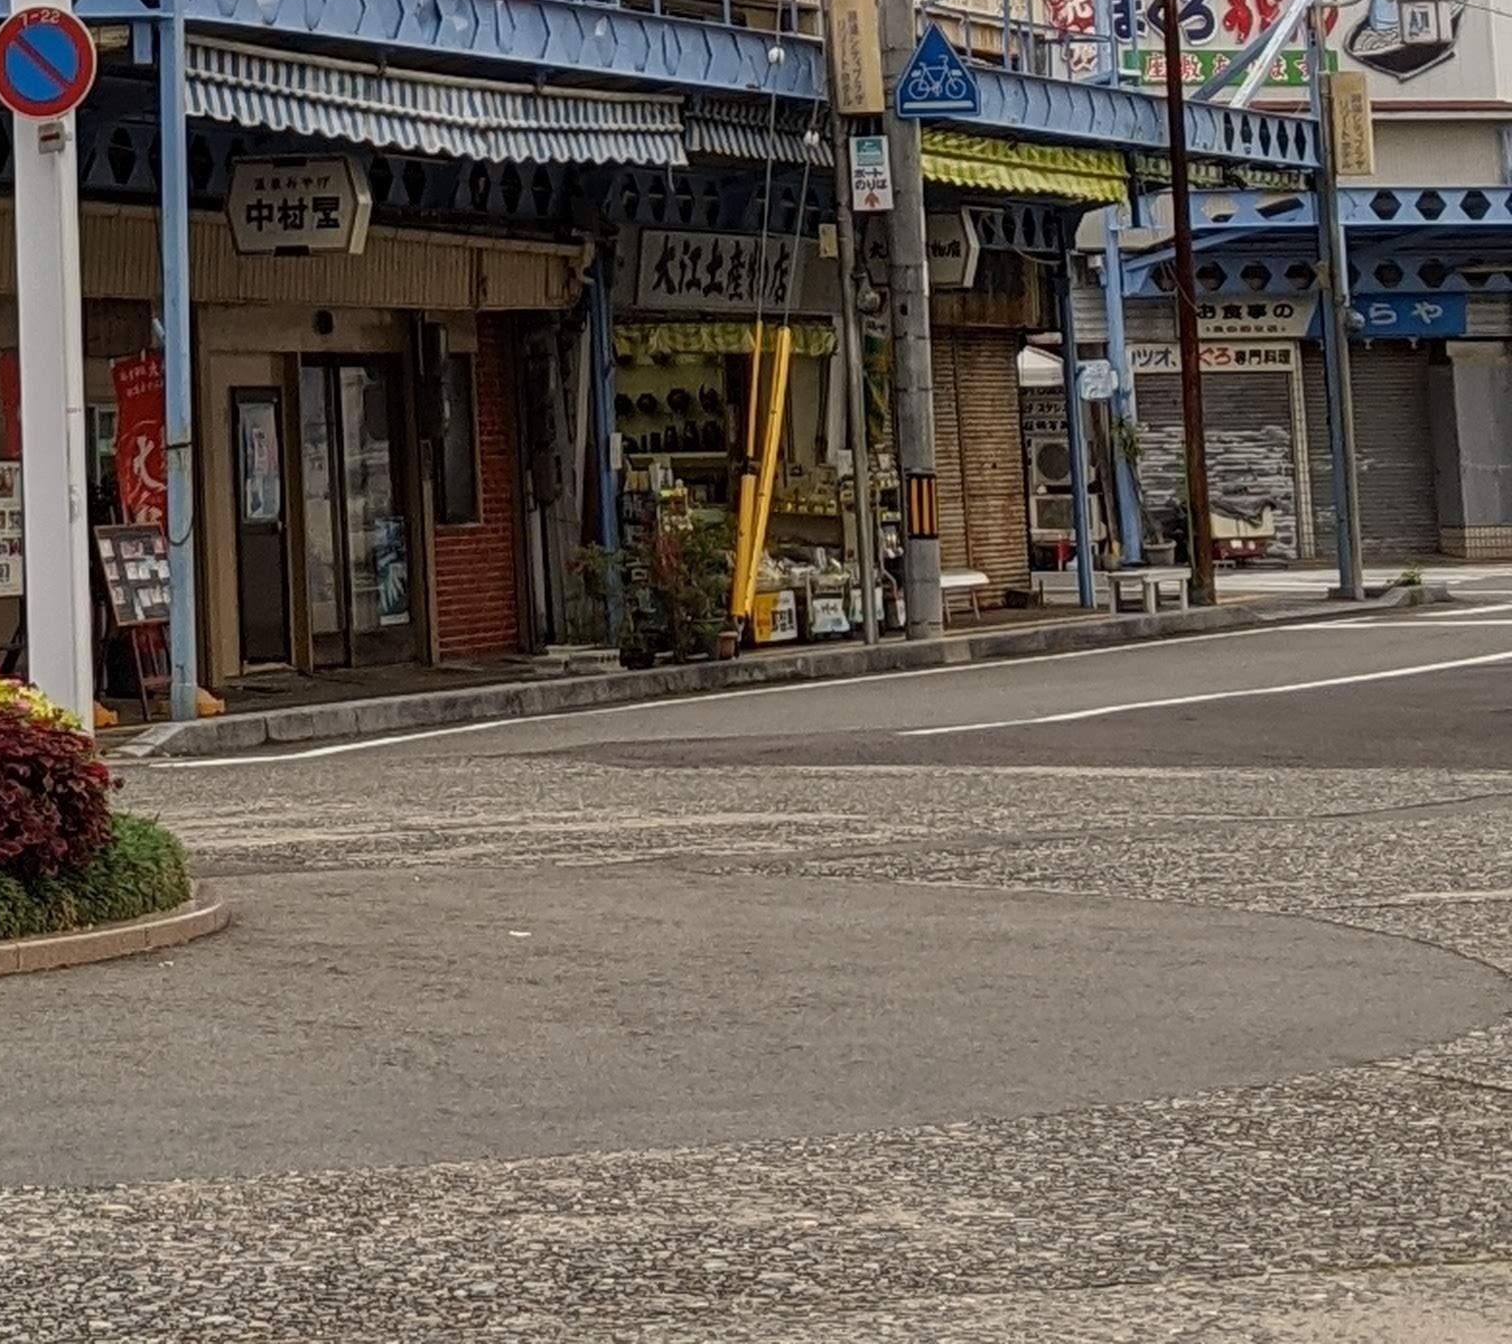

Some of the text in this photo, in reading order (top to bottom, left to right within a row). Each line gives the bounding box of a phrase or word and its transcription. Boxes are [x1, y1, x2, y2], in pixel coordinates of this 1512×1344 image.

[1145, 50, 1316, 81] 座敷あます
[246, 196, 340, 232] 中村屋
[870, 240, 962, 259] 大物店
[1197, 303, 1294, 320] お食事の
[1131, 346, 1292, 368] ツオ、ぐろ専門料理
